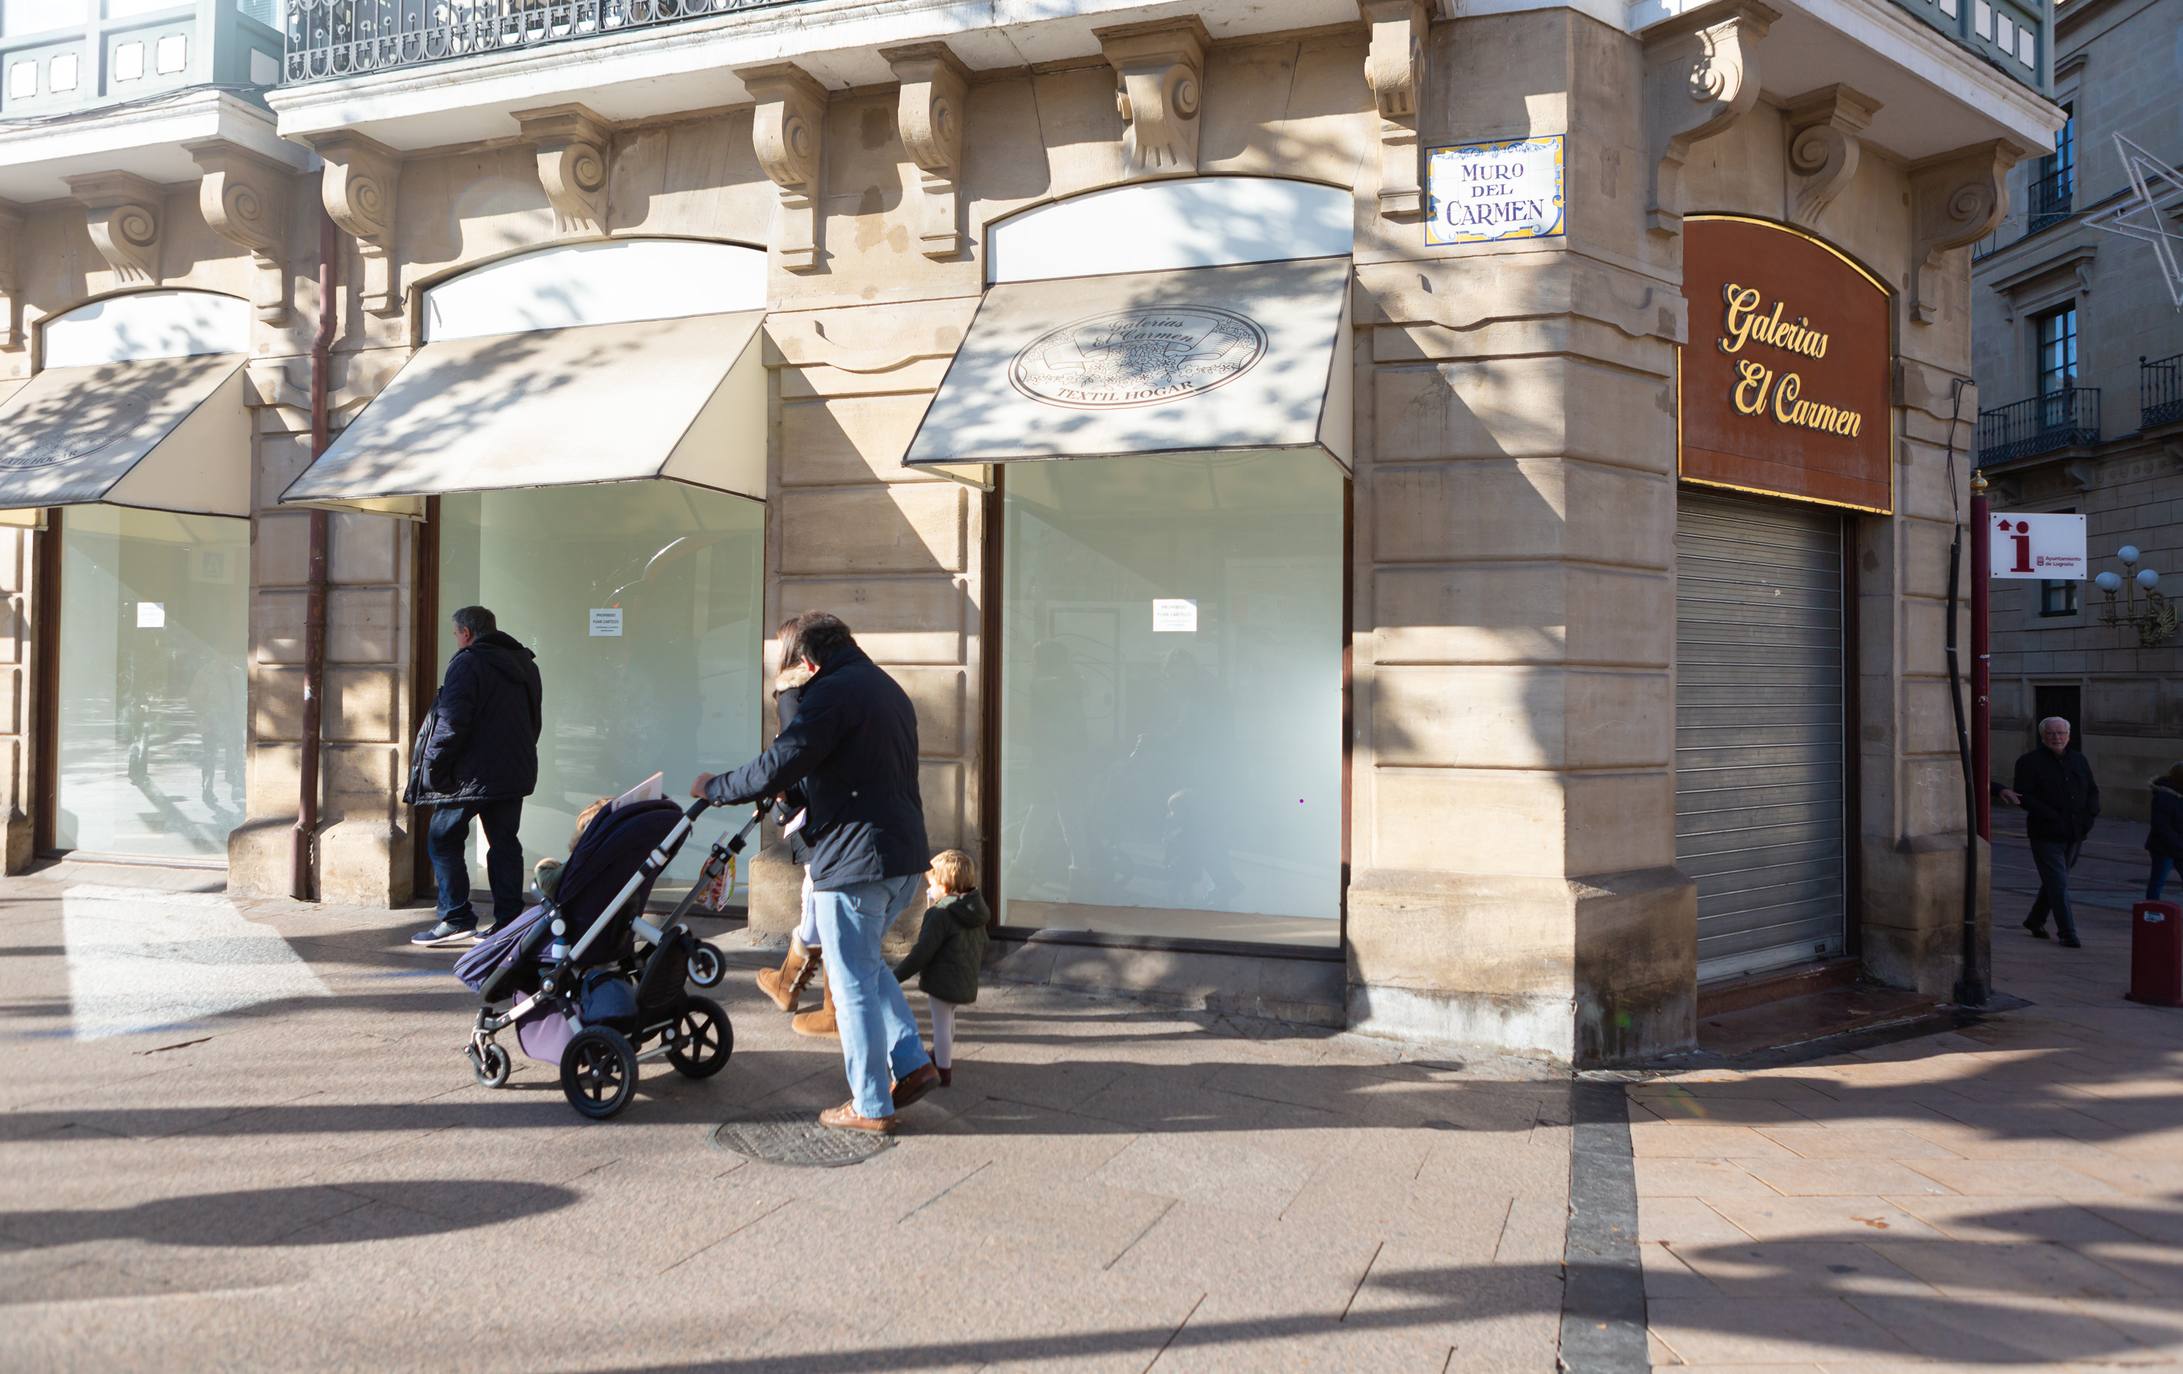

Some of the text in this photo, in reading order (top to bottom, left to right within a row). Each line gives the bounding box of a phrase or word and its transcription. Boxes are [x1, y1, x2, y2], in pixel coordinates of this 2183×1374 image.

[1461, 163, 1525, 182] MURO
[1471, 184, 1514, 198] DEL
[1446, 198, 1545, 226] CARMEN
[1108, 317, 1184, 332] Galerias
[1719, 283, 1829, 358] Galerias
[1093, 329, 1194, 347] El Carmen
[1057, 381, 1194, 401] TEXTIL HOGAR
[1733, 359, 1862, 437] El Carmen
